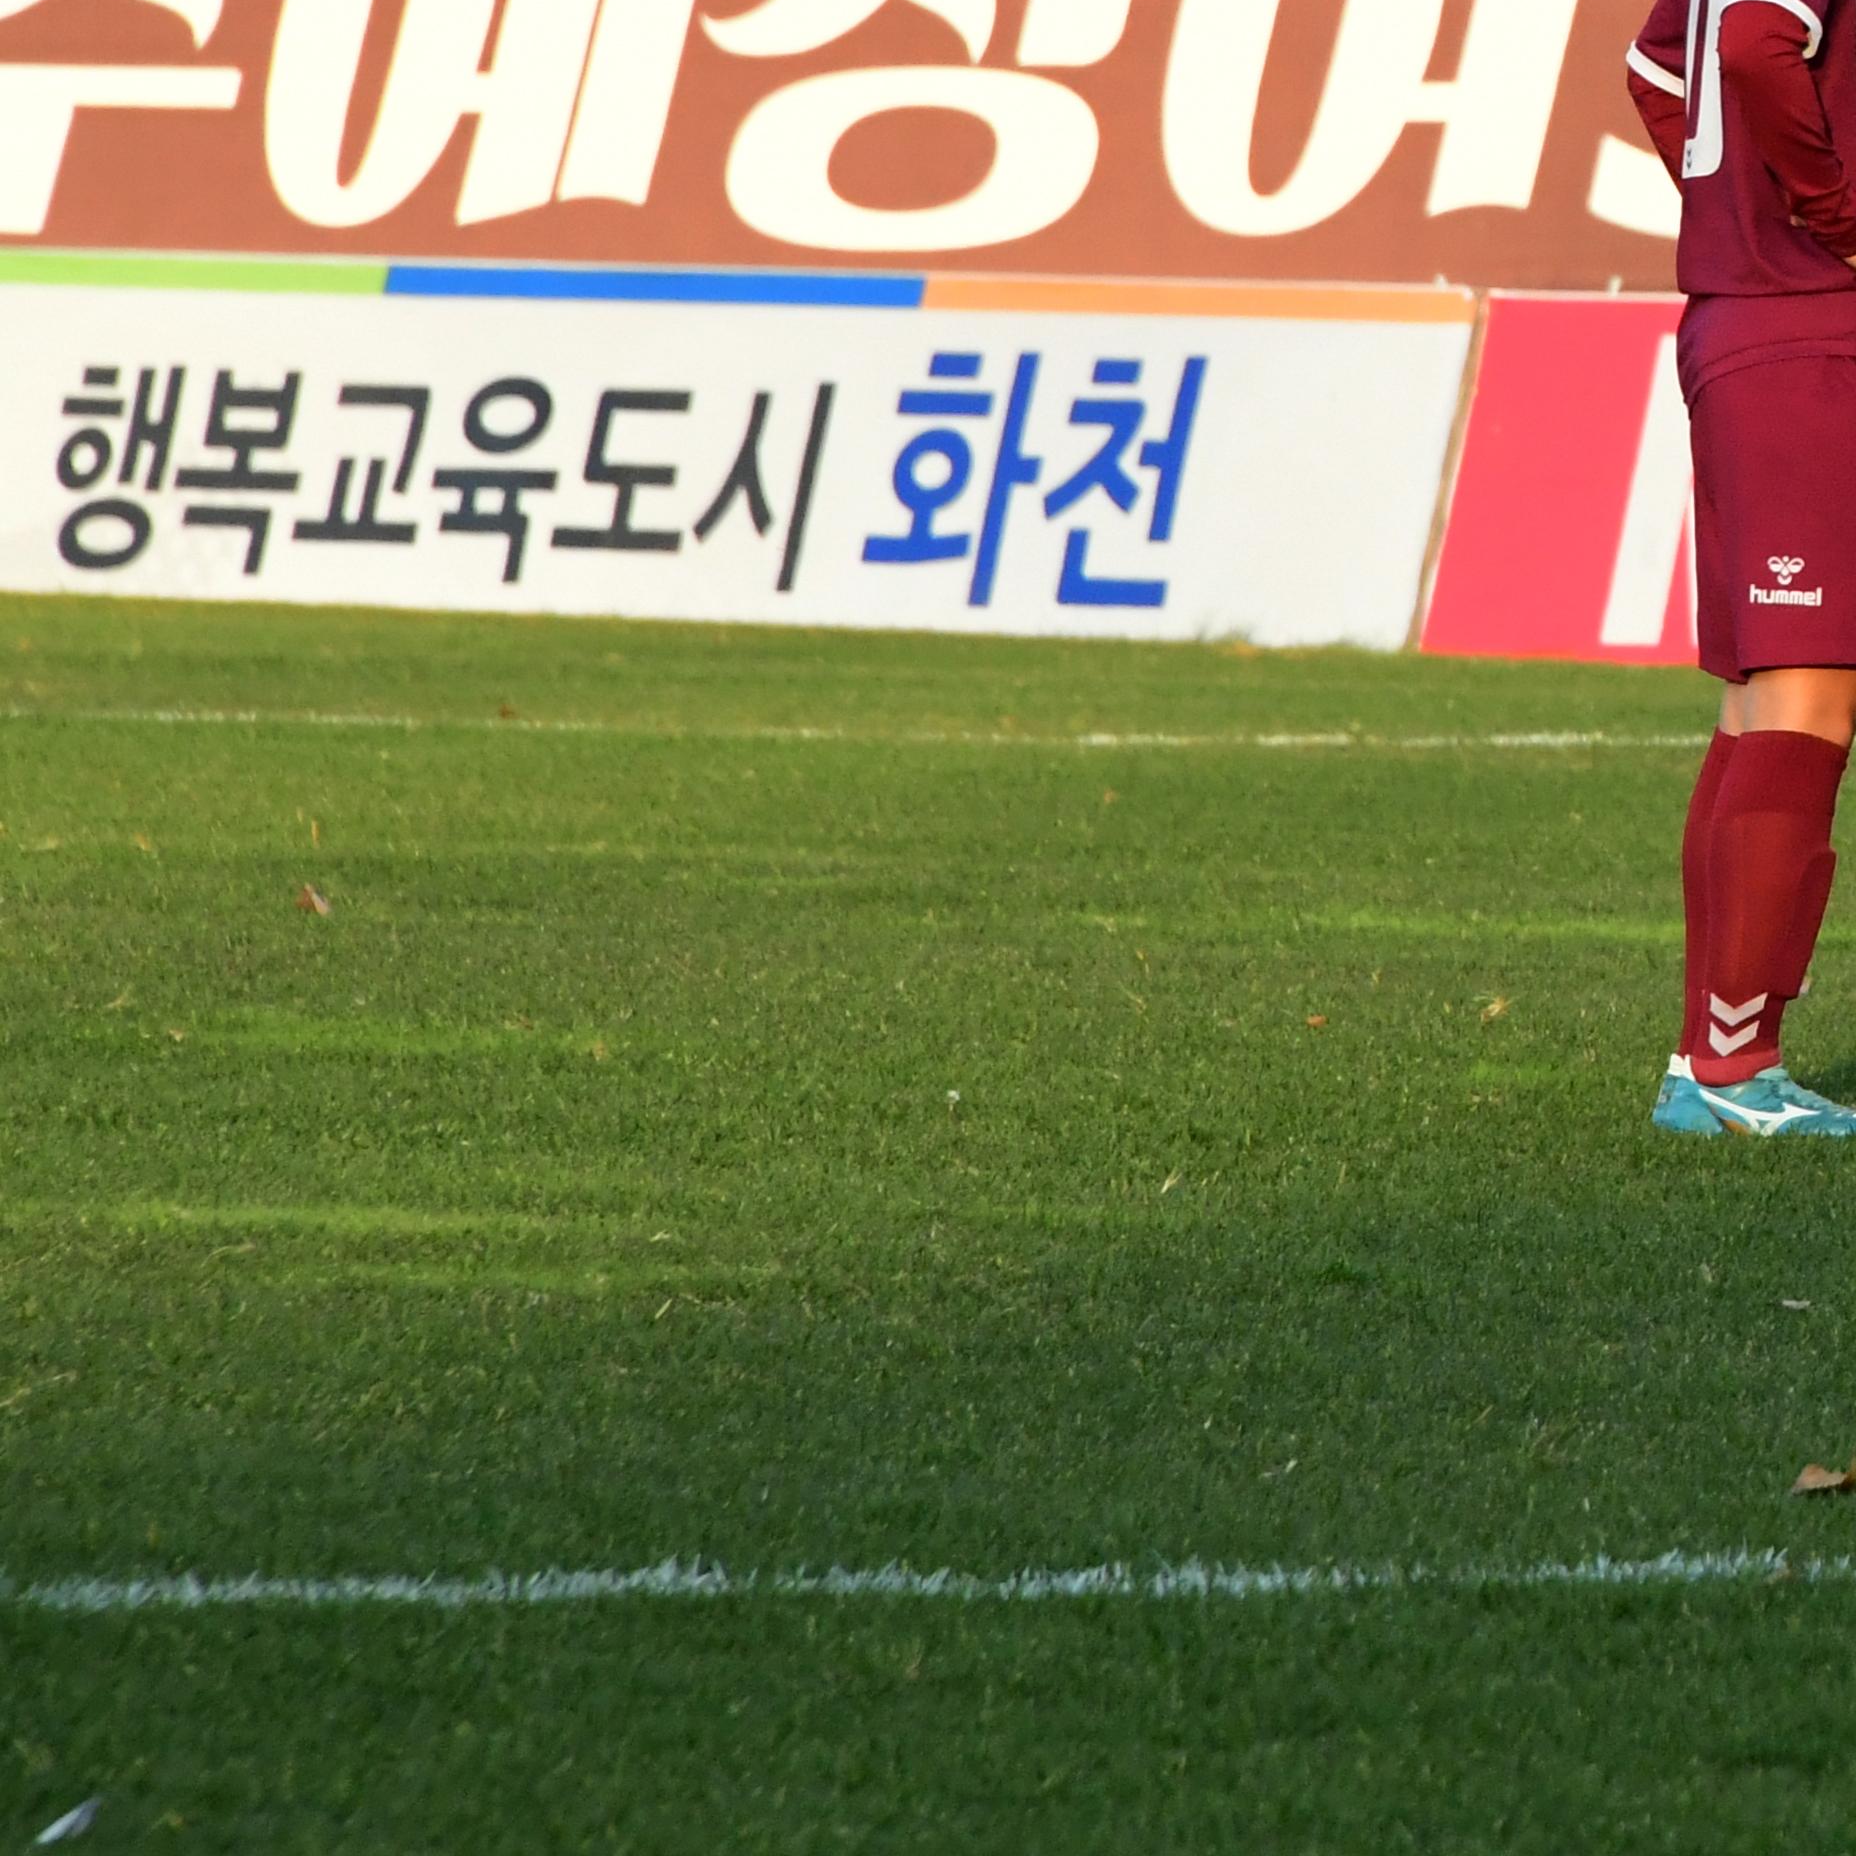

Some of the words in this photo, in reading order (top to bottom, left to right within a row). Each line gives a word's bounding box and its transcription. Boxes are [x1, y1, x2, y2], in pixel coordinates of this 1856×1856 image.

[56, 363, 836, 592] 행복교육도시
[862, 351, 1209, 608] 화천
[1750, 584, 1822, 606] hummel
